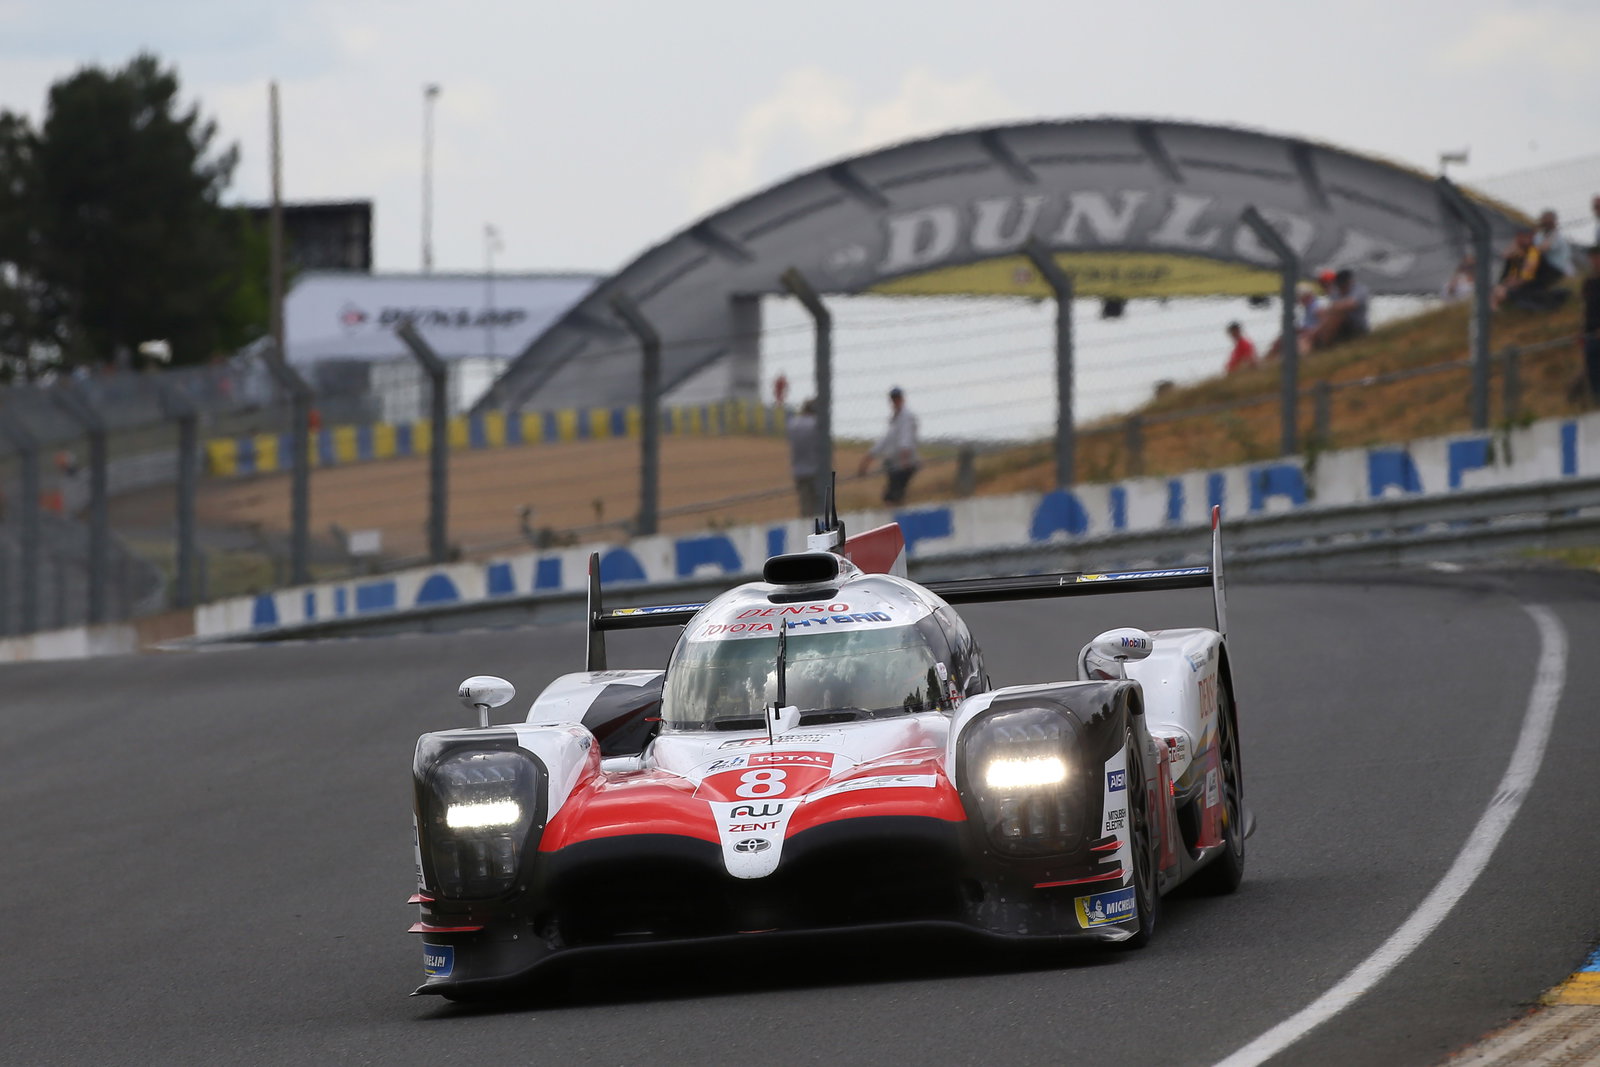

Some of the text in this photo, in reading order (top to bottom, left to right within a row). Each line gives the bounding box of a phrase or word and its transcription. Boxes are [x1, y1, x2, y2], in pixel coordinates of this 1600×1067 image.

[876, 190, 1416, 276] DUNLOP
[736, 603, 849, 619] DENSO
[701, 611, 892, 636] TOYOTA HYBRID
[752, 755, 829, 763] TOTAL
[735, 768, 787, 798] 8
[728, 820, 781, 833] ZENT
